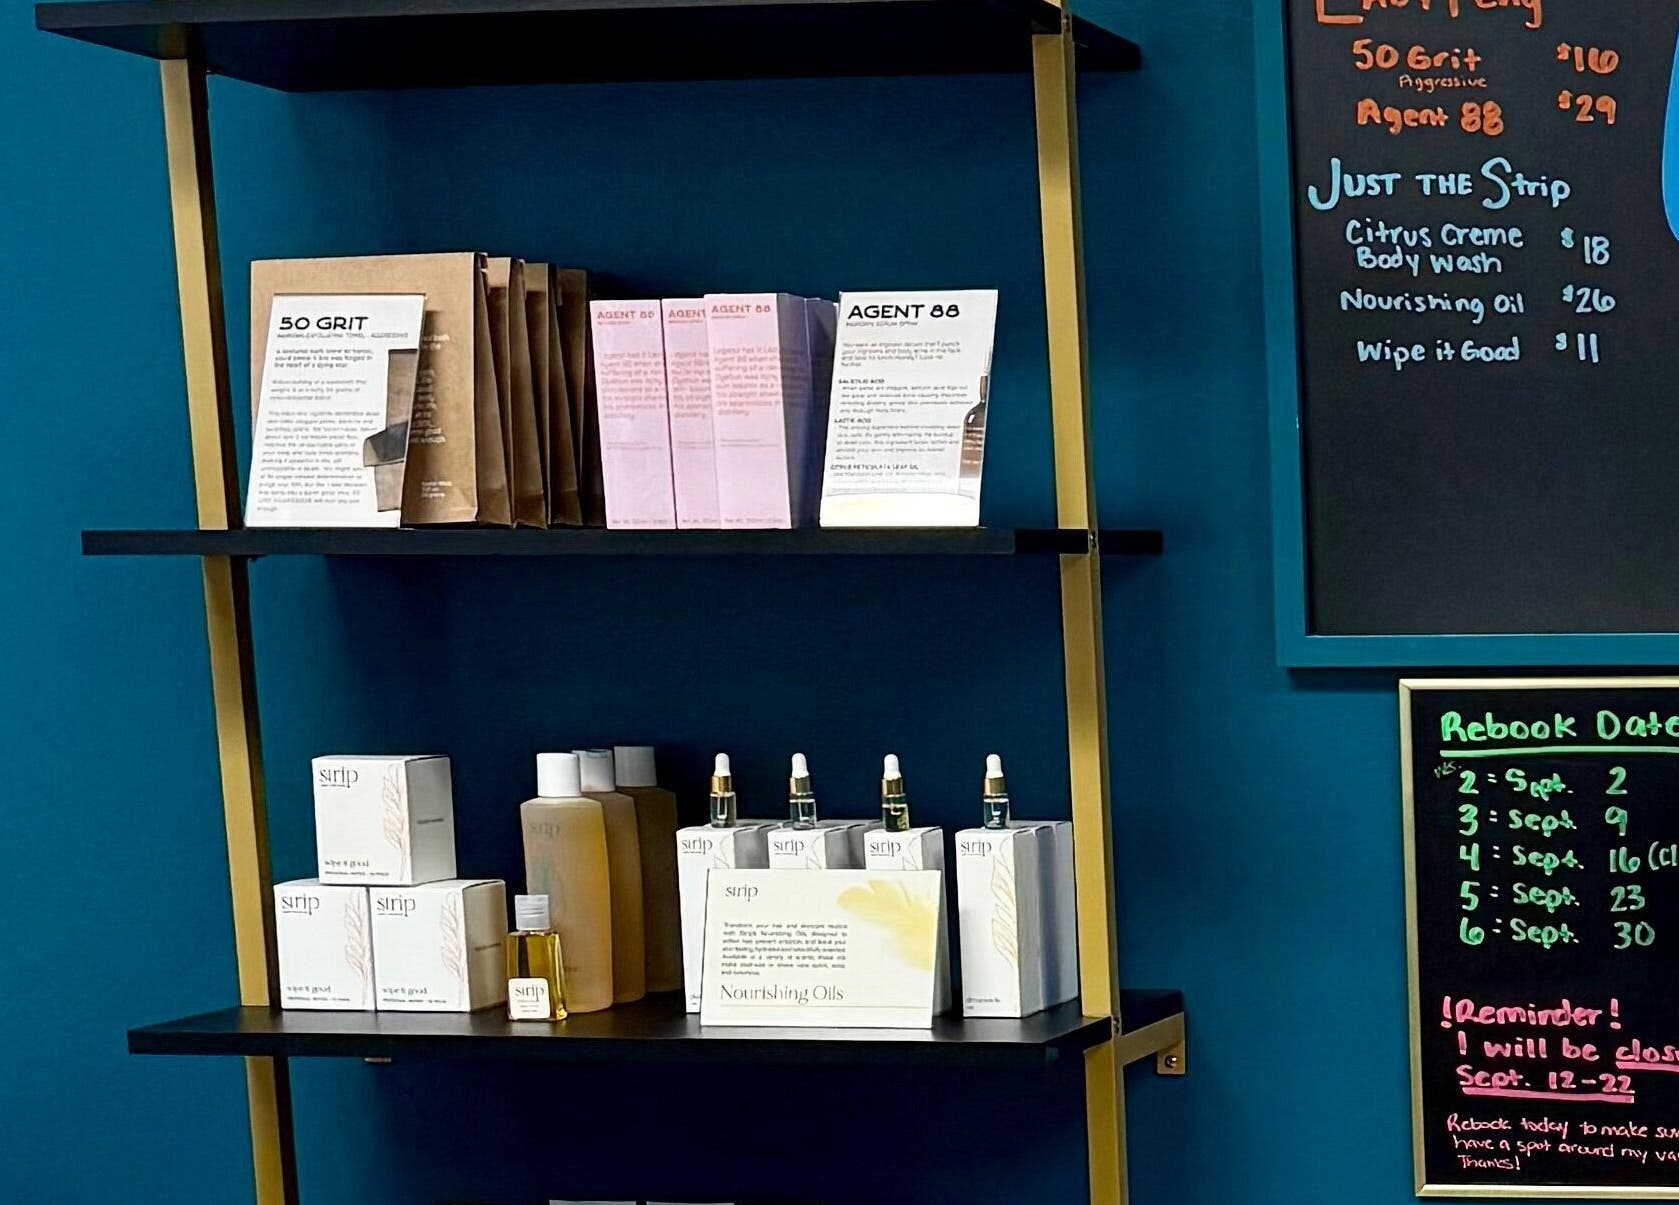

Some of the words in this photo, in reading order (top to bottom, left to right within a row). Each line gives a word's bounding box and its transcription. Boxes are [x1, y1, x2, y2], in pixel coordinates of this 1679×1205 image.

[1353, 39, 1399, 70] 50
[1407, 45, 1482, 72] Grit
[1557, 43, 1619, 74] $16
[1399, 74, 1488, 93] Aggressive
[1357, 98, 1448, 135] Agent
[1460, 101, 1504, 136] 88
[1558, 90, 1617, 125] $29
[1415, 173, 1473, 196] THE
[1481, 156, 1571, 209] Strip
[1345, 218, 1433, 249] Citrus
[1440, 223, 1524, 248] Creme
[1356, 246, 1419, 278] Body
[597, 310, 636, 319] AGENT
[711, 305, 751, 313] AGENT
[848, 304, 925, 319] AGENT
[930, 304, 960, 318] 88
[1340, 288, 1485, 324] Nourishing
[1494, 292, 1525, 314] Oil
[1562, 284, 1616, 314] $26
[279, 316, 310, 331] 50
[316, 316, 369, 331] GRIT
[1357, 340, 1426, 371] Wipe
[1436, 342, 1454, 361] it
[1460, 336, 1521, 361] Good
[1440, 710, 1577, 742] Rebook
[1458, 770, 1479, 794] 2
[1606, 766, 1628, 795] 2
[1458, 803, 1479, 836] 3
[1605, 805, 1628, 837] 9
[1459, 842, 1480, 871] 4
[1609, 846, 1641, 874] 16
[1459, 880, 1480, 911] 5
[1610, 884, 1646, 912] 23
[1459, 916, 1485, 945] 6
[1613, 920, 1656, 949] 30
[721, 984, 808, 1007] Nourishing
[813, 985, 843, 1001] Oils
[1457, 1030, 1467, 1056] I
[1483, 1036, 1548, 1059] will
[1562, 1037, 1600, 1061] be
[1446, 1112, 1512, 1133] Rebook
[1520, 1116, 1569, 1139] today
[1579, 1120, 1598, 1135] to
[1600, 1122, 1648, 1138] make
[1452, 1134, 1494, 1150] have
[1499, 1139, 1510, 1151] a
[1516, 1140, 1551, 1157] spot
[1558, 1144, 1614, 1157] around
[1621, 1148, 1648, 1164] my
[1457, 1154, 1521, 1170] Thanks!
